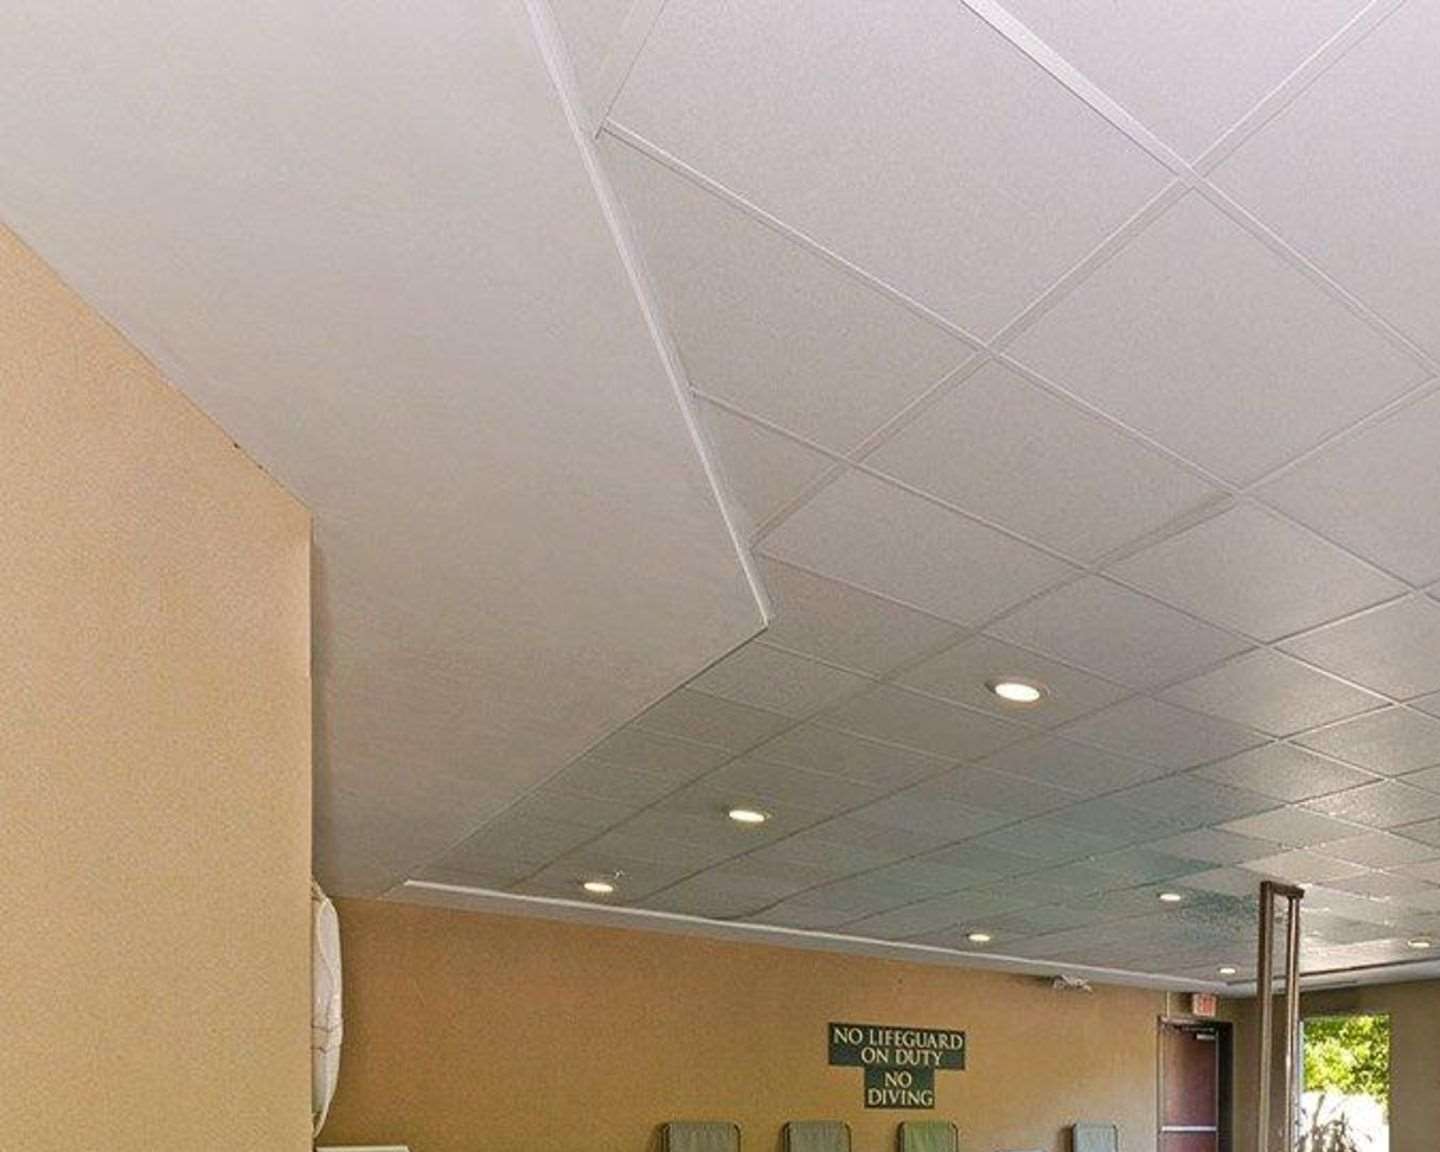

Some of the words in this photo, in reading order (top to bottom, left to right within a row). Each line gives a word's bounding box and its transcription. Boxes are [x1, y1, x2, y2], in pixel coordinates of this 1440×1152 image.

[833, 1027, 863, 1045] NO
[869, 1030, 963, 1049] LIFEGUARD
[861, 1047, 888, 1064] ON
[895, 1049, 943, 1065] DUTY
[885, 1071, 912, 1088] NO
[868, 1089, 933, 1105] DIVING
